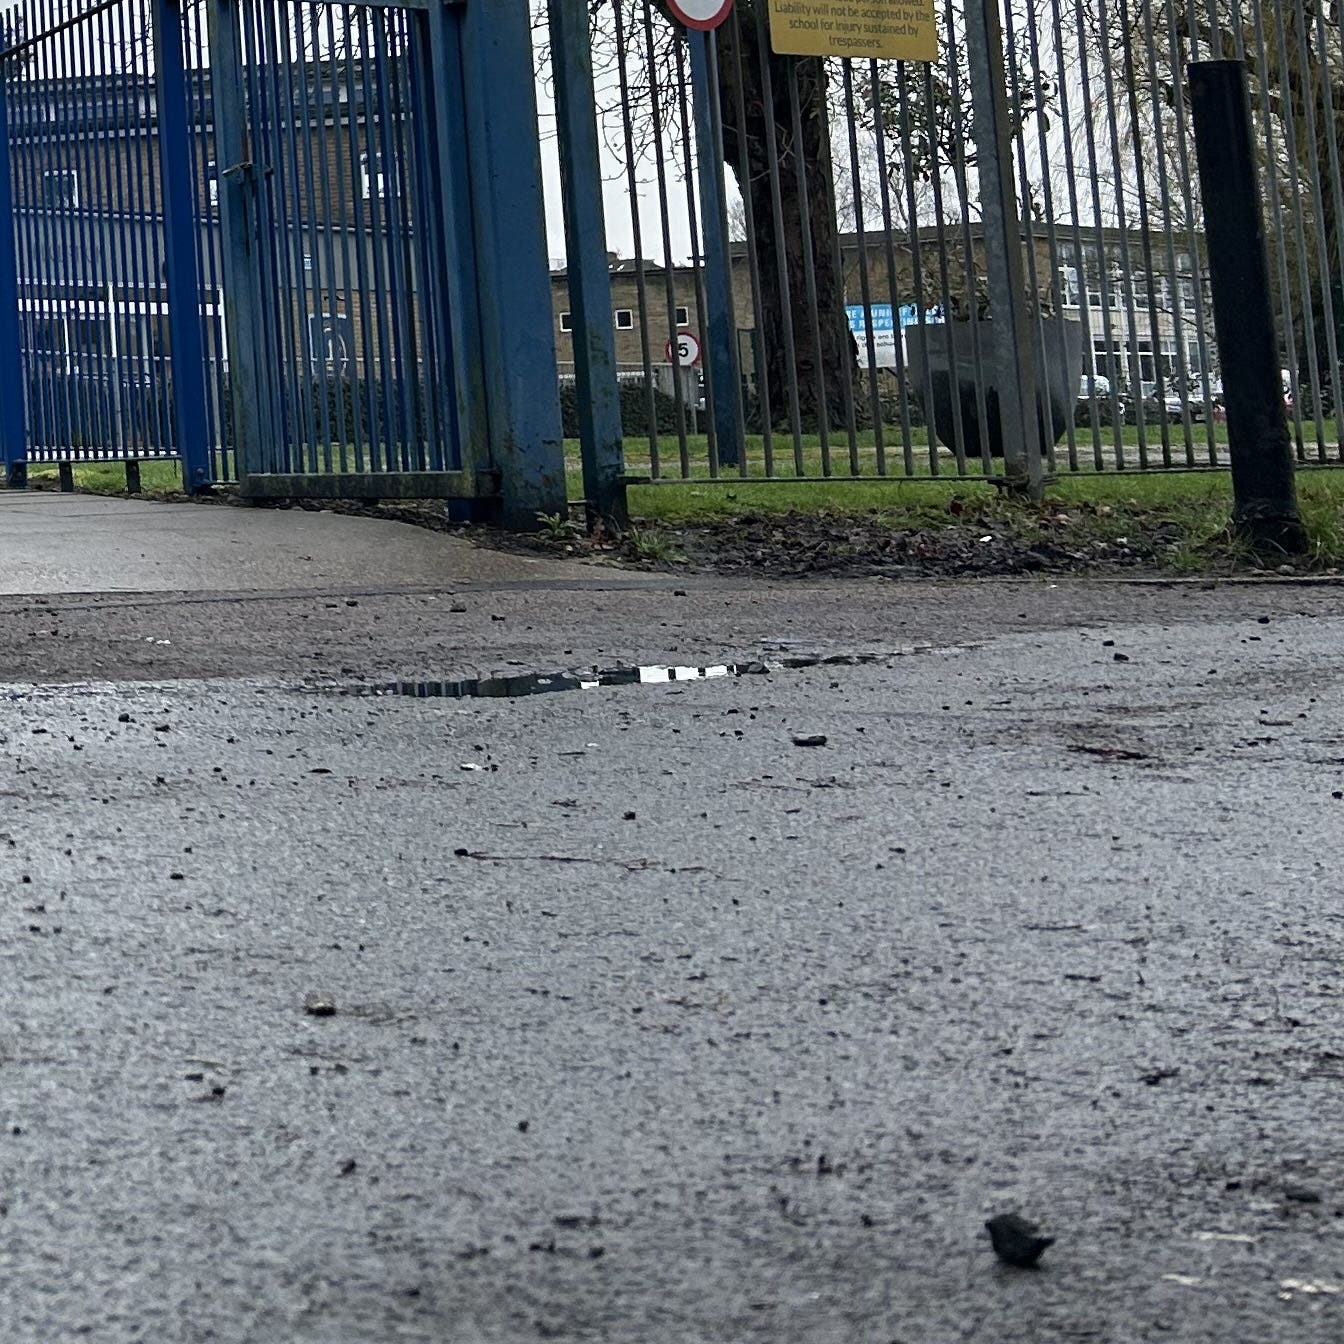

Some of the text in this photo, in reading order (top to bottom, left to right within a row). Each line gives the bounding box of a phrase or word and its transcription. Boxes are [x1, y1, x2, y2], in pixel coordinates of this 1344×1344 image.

[775, 1, 930, 22] Liability will not be accepted by the
[789, 17, 918, 37] school for injury sustained by
